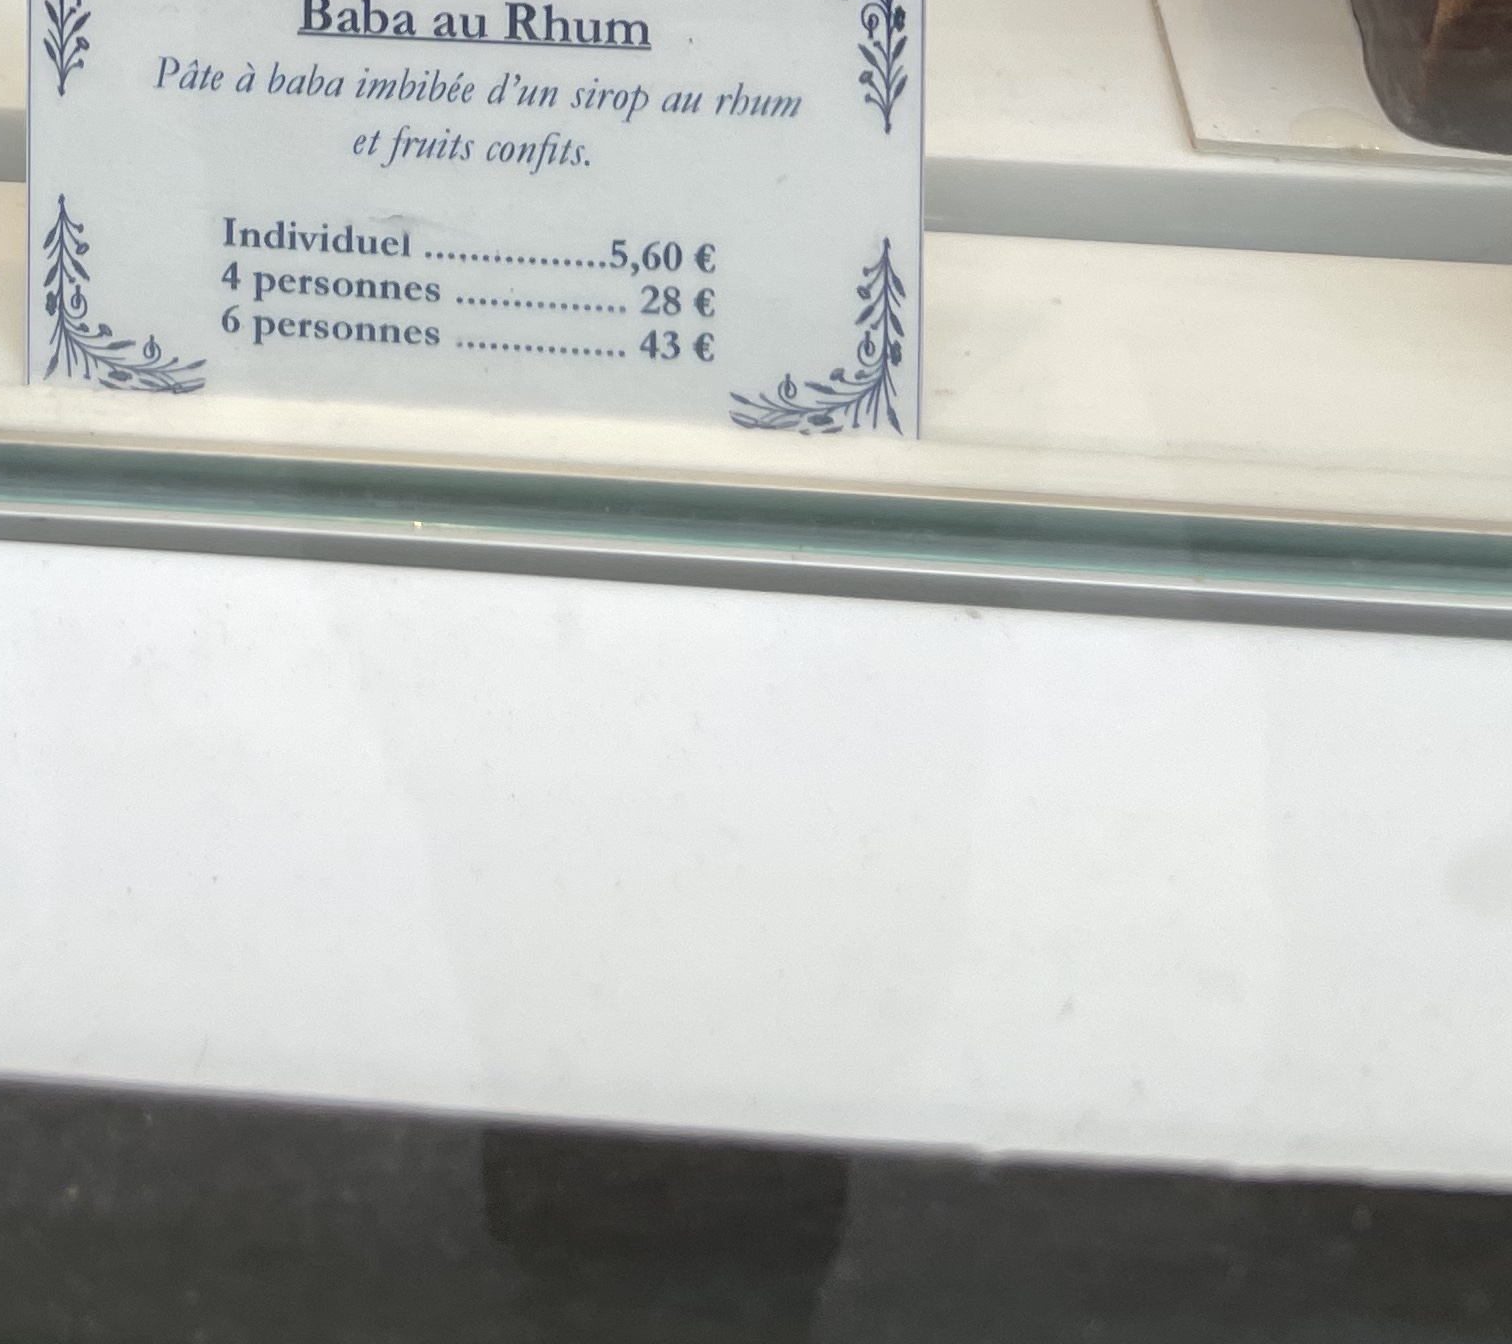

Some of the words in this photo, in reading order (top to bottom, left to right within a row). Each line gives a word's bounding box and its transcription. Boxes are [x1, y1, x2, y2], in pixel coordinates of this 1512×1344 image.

[433, 10, 489, 40] au
[504, 0, 652, 46] Rhum
[153, 55, 225, 92] Pâte
[235, 62, 256, 94] à
[267, 61, 345, 98] baba
[354, 67, 475, 104] imbibée
[570, 78, 650, 123] sirop
[661, 91, 703, 114] au
[715, 82, 803, 118] rhum
[352, 129, 381, 155] et
[380, 124, 475, 169] fruits
[485, 131, 591, 176] confits.
[222, 216, 411, 258] Individuel
[609, 239, 683, 277] 5,60
[694, 243, 716, 275] €
[220, 260, 242, 291] 4
[252, 271, 441, 303] personnes
[640, 284, 682, 317] 28
[693, 287, 716, 319] €
[221, 304, 241, 334] 6
[252, 314, 441, 346] personnes
[640, 329, 681, 361] 43
[693, 331, 715, 363] €
